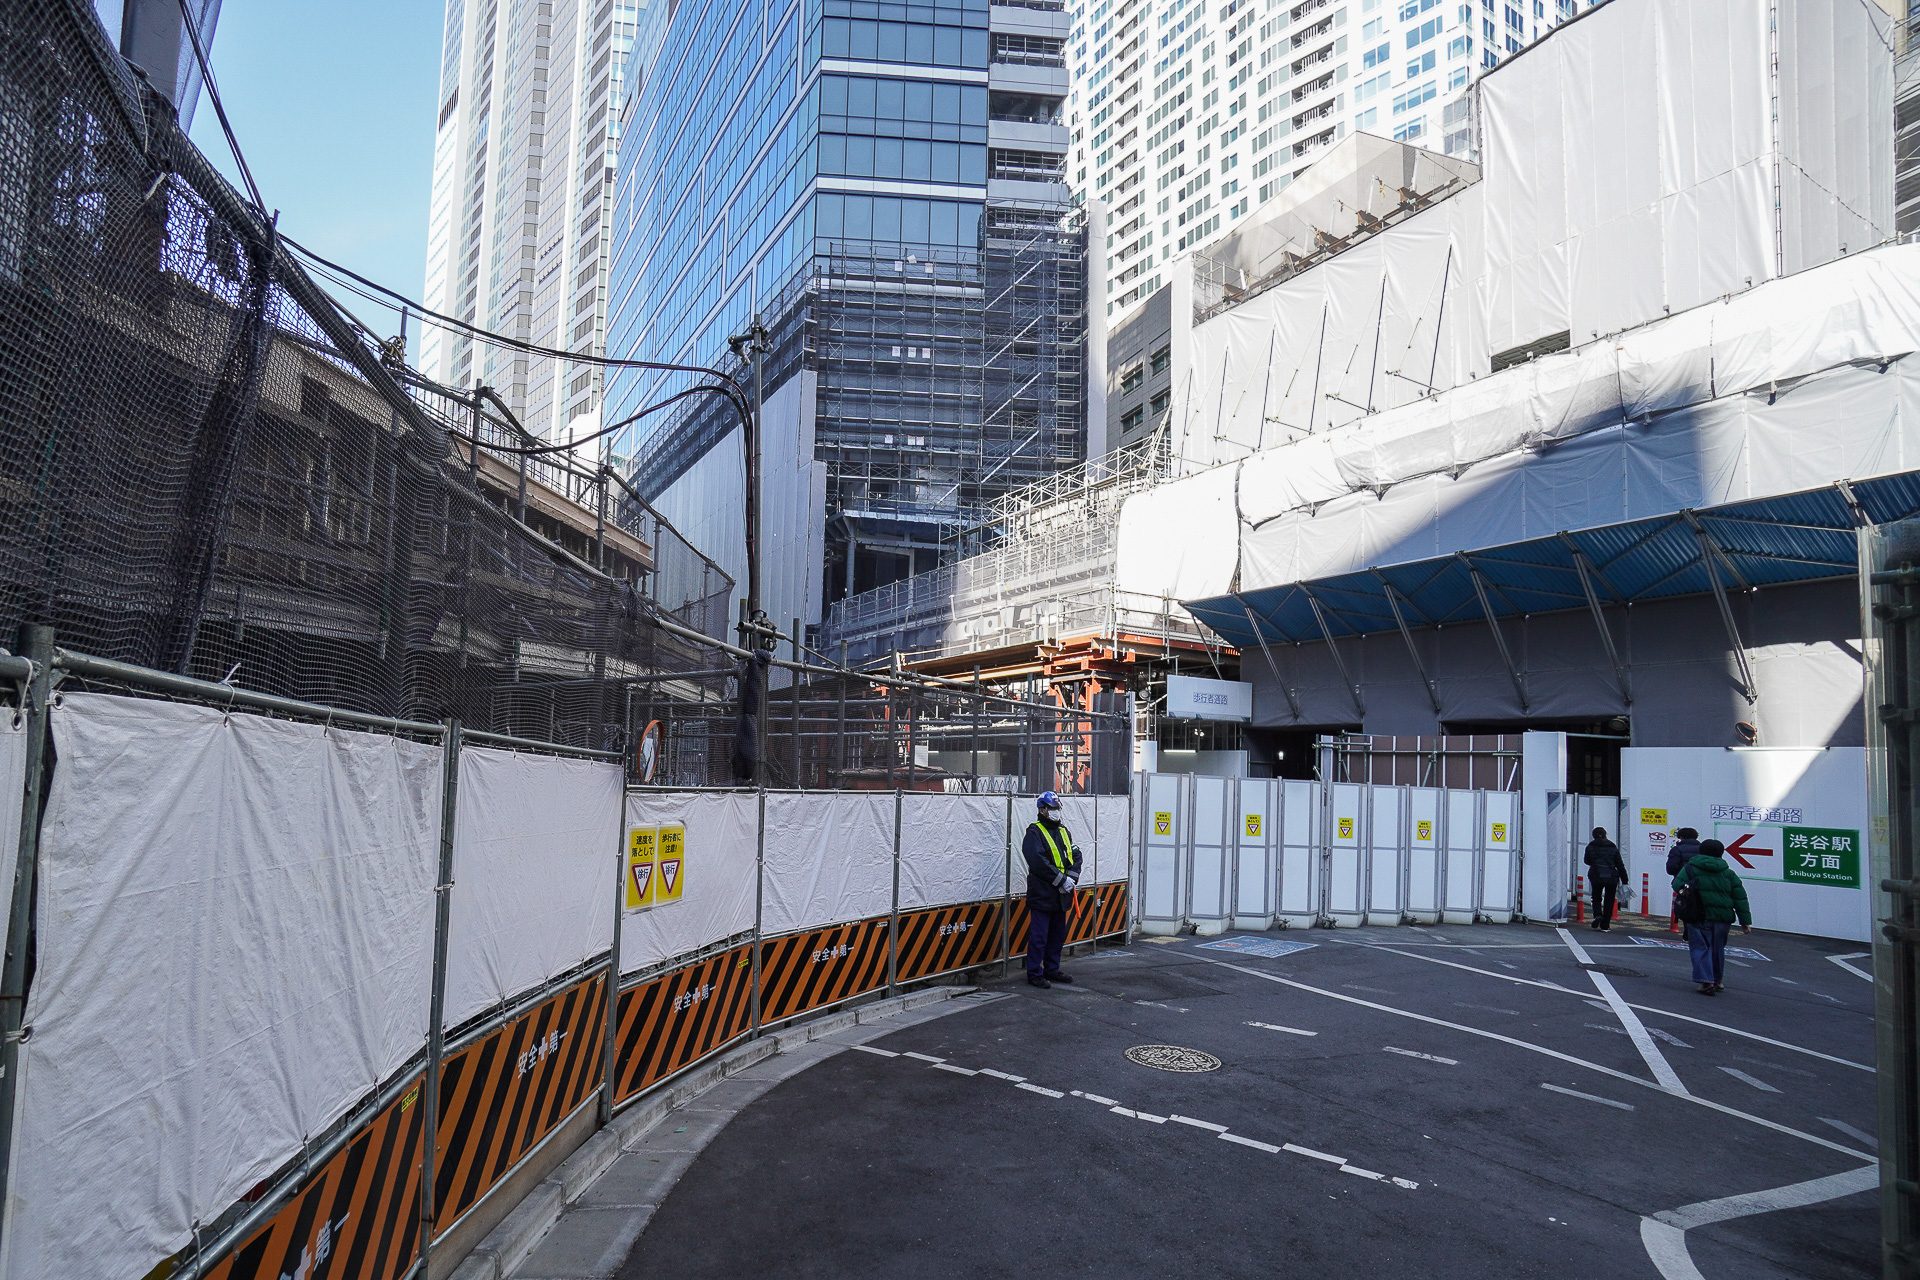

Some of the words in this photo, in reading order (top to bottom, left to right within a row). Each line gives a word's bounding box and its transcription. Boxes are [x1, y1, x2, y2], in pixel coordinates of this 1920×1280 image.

[1711, 805, 1801, 824] 歩行者通路
[636, 836, 653, 845] 速度を
[662, 833, 681, 842] 歩行者に
[1789, 833, 1852, 852] 渋谷駅
[1799, 852, 1841, 870] 方面
[638, 869, 648, 879] 徐行
[665, 865, 675, 875] 徐行
[1789, 869, 1821, 879] Shibuya
[1823, 872, 1853, 881] Station
